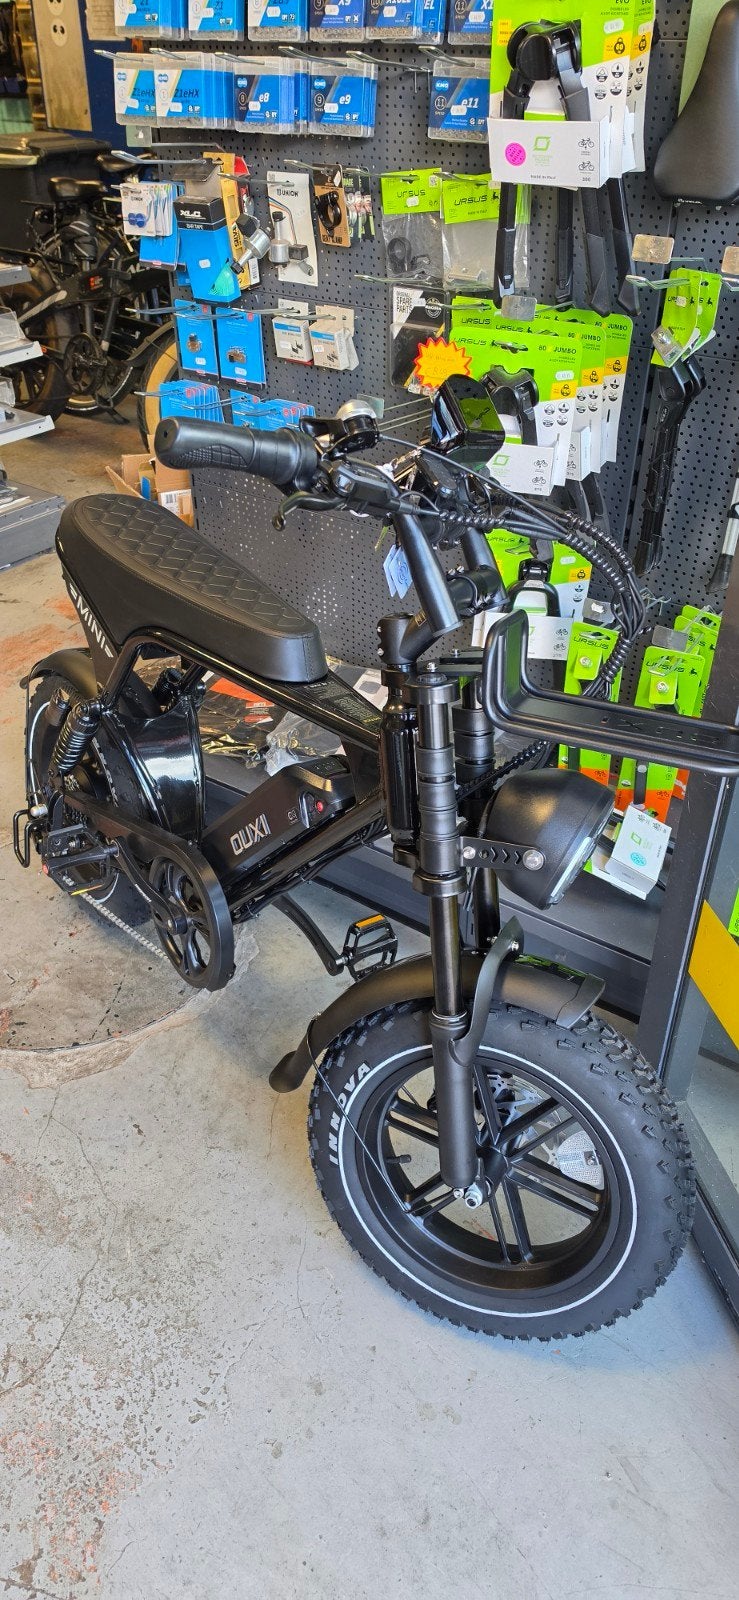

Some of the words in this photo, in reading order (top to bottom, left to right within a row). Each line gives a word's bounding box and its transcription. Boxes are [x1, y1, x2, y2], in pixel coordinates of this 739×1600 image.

[174, 88, 200, 98] Z1eHX
[259, 92, 270, 103] e8
[339, 94, 352, 105] e9
[461, 97, 479, 109] e11
[454, 194, 488, 206] URSUS
[607, 323, 628, 331] JUMBO
[573, 635, 609, 650] URSUS
[229, 813, 272, 856] OUXI
[328, 1062, 371, 1166] INNOVA
